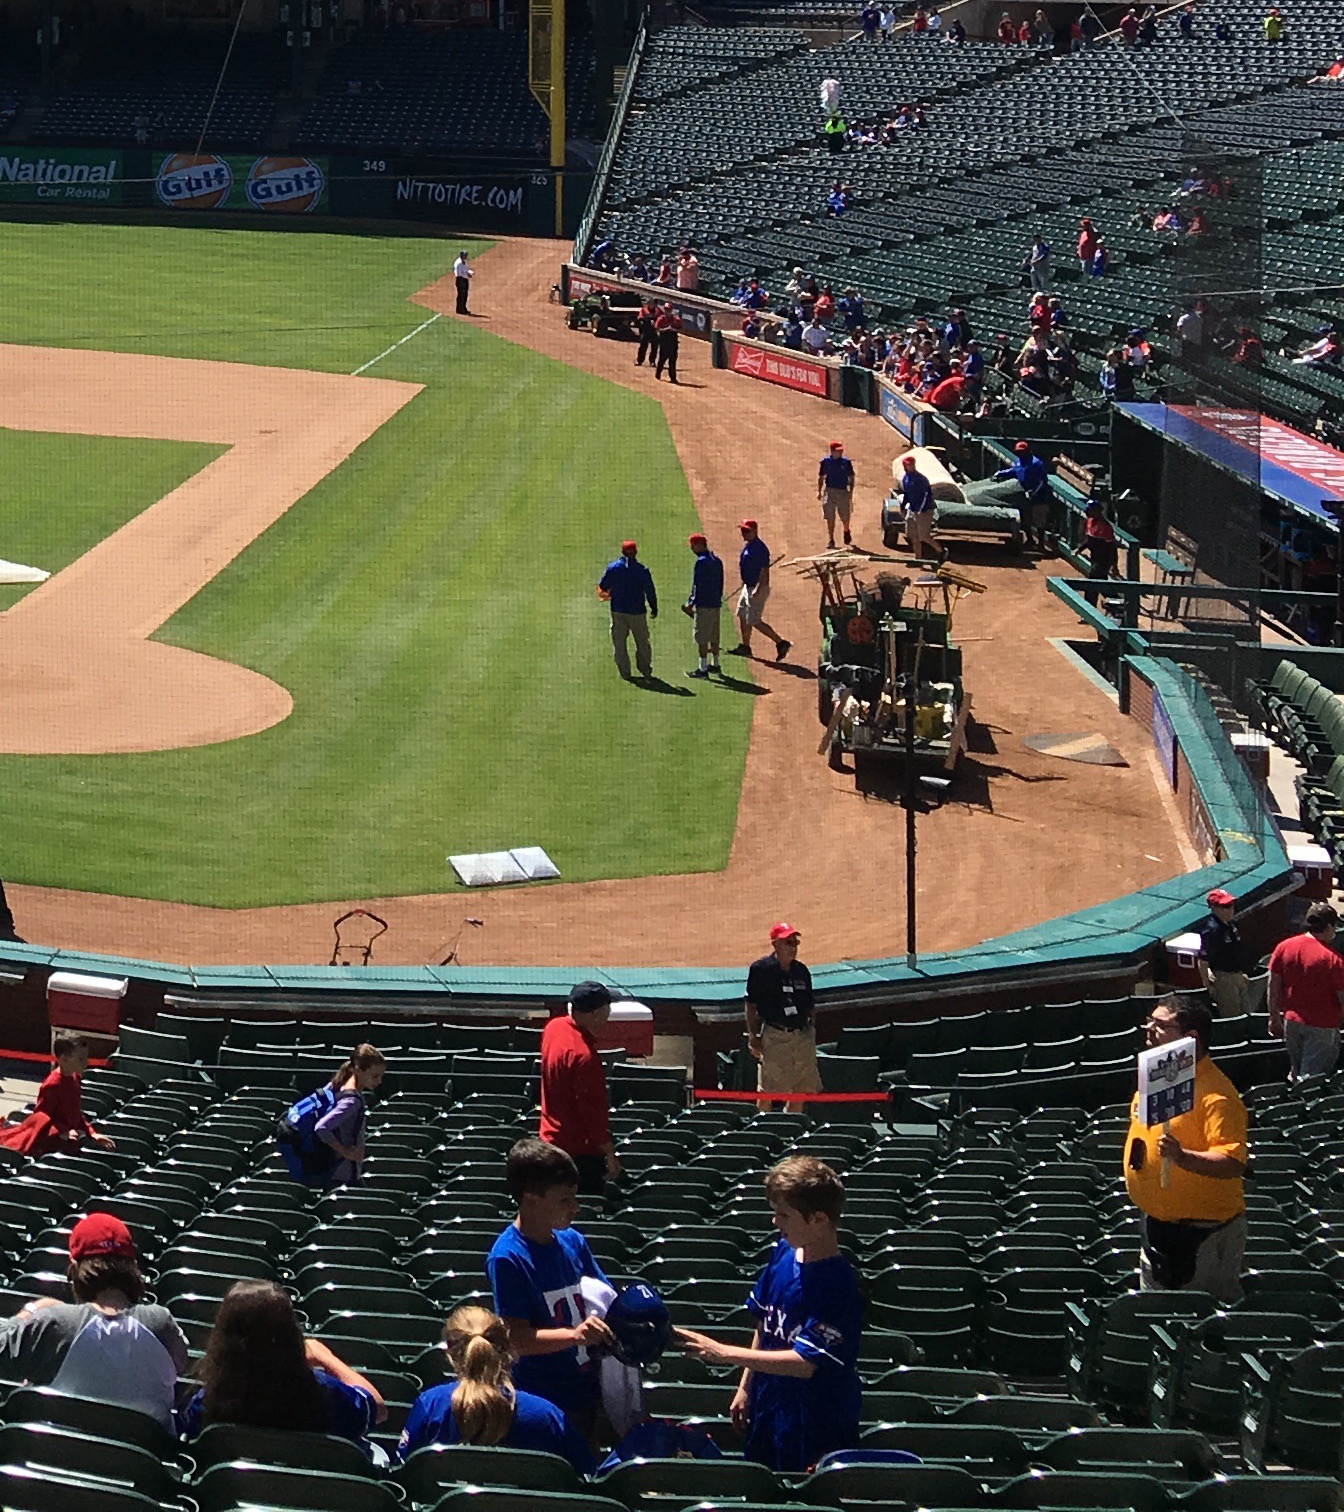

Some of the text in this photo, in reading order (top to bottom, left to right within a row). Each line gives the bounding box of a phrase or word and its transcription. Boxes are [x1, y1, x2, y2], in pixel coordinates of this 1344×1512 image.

[362, 160, 387, 172] 349
[160, 167, 227, 197] Gulf
[250, 170, 317, 201] Gulf
[531, 173, 548, 186] 325
[36, 186, 111, 200] Car Rental
[396, 178, 524, 216] NITTOTIRE.COM
